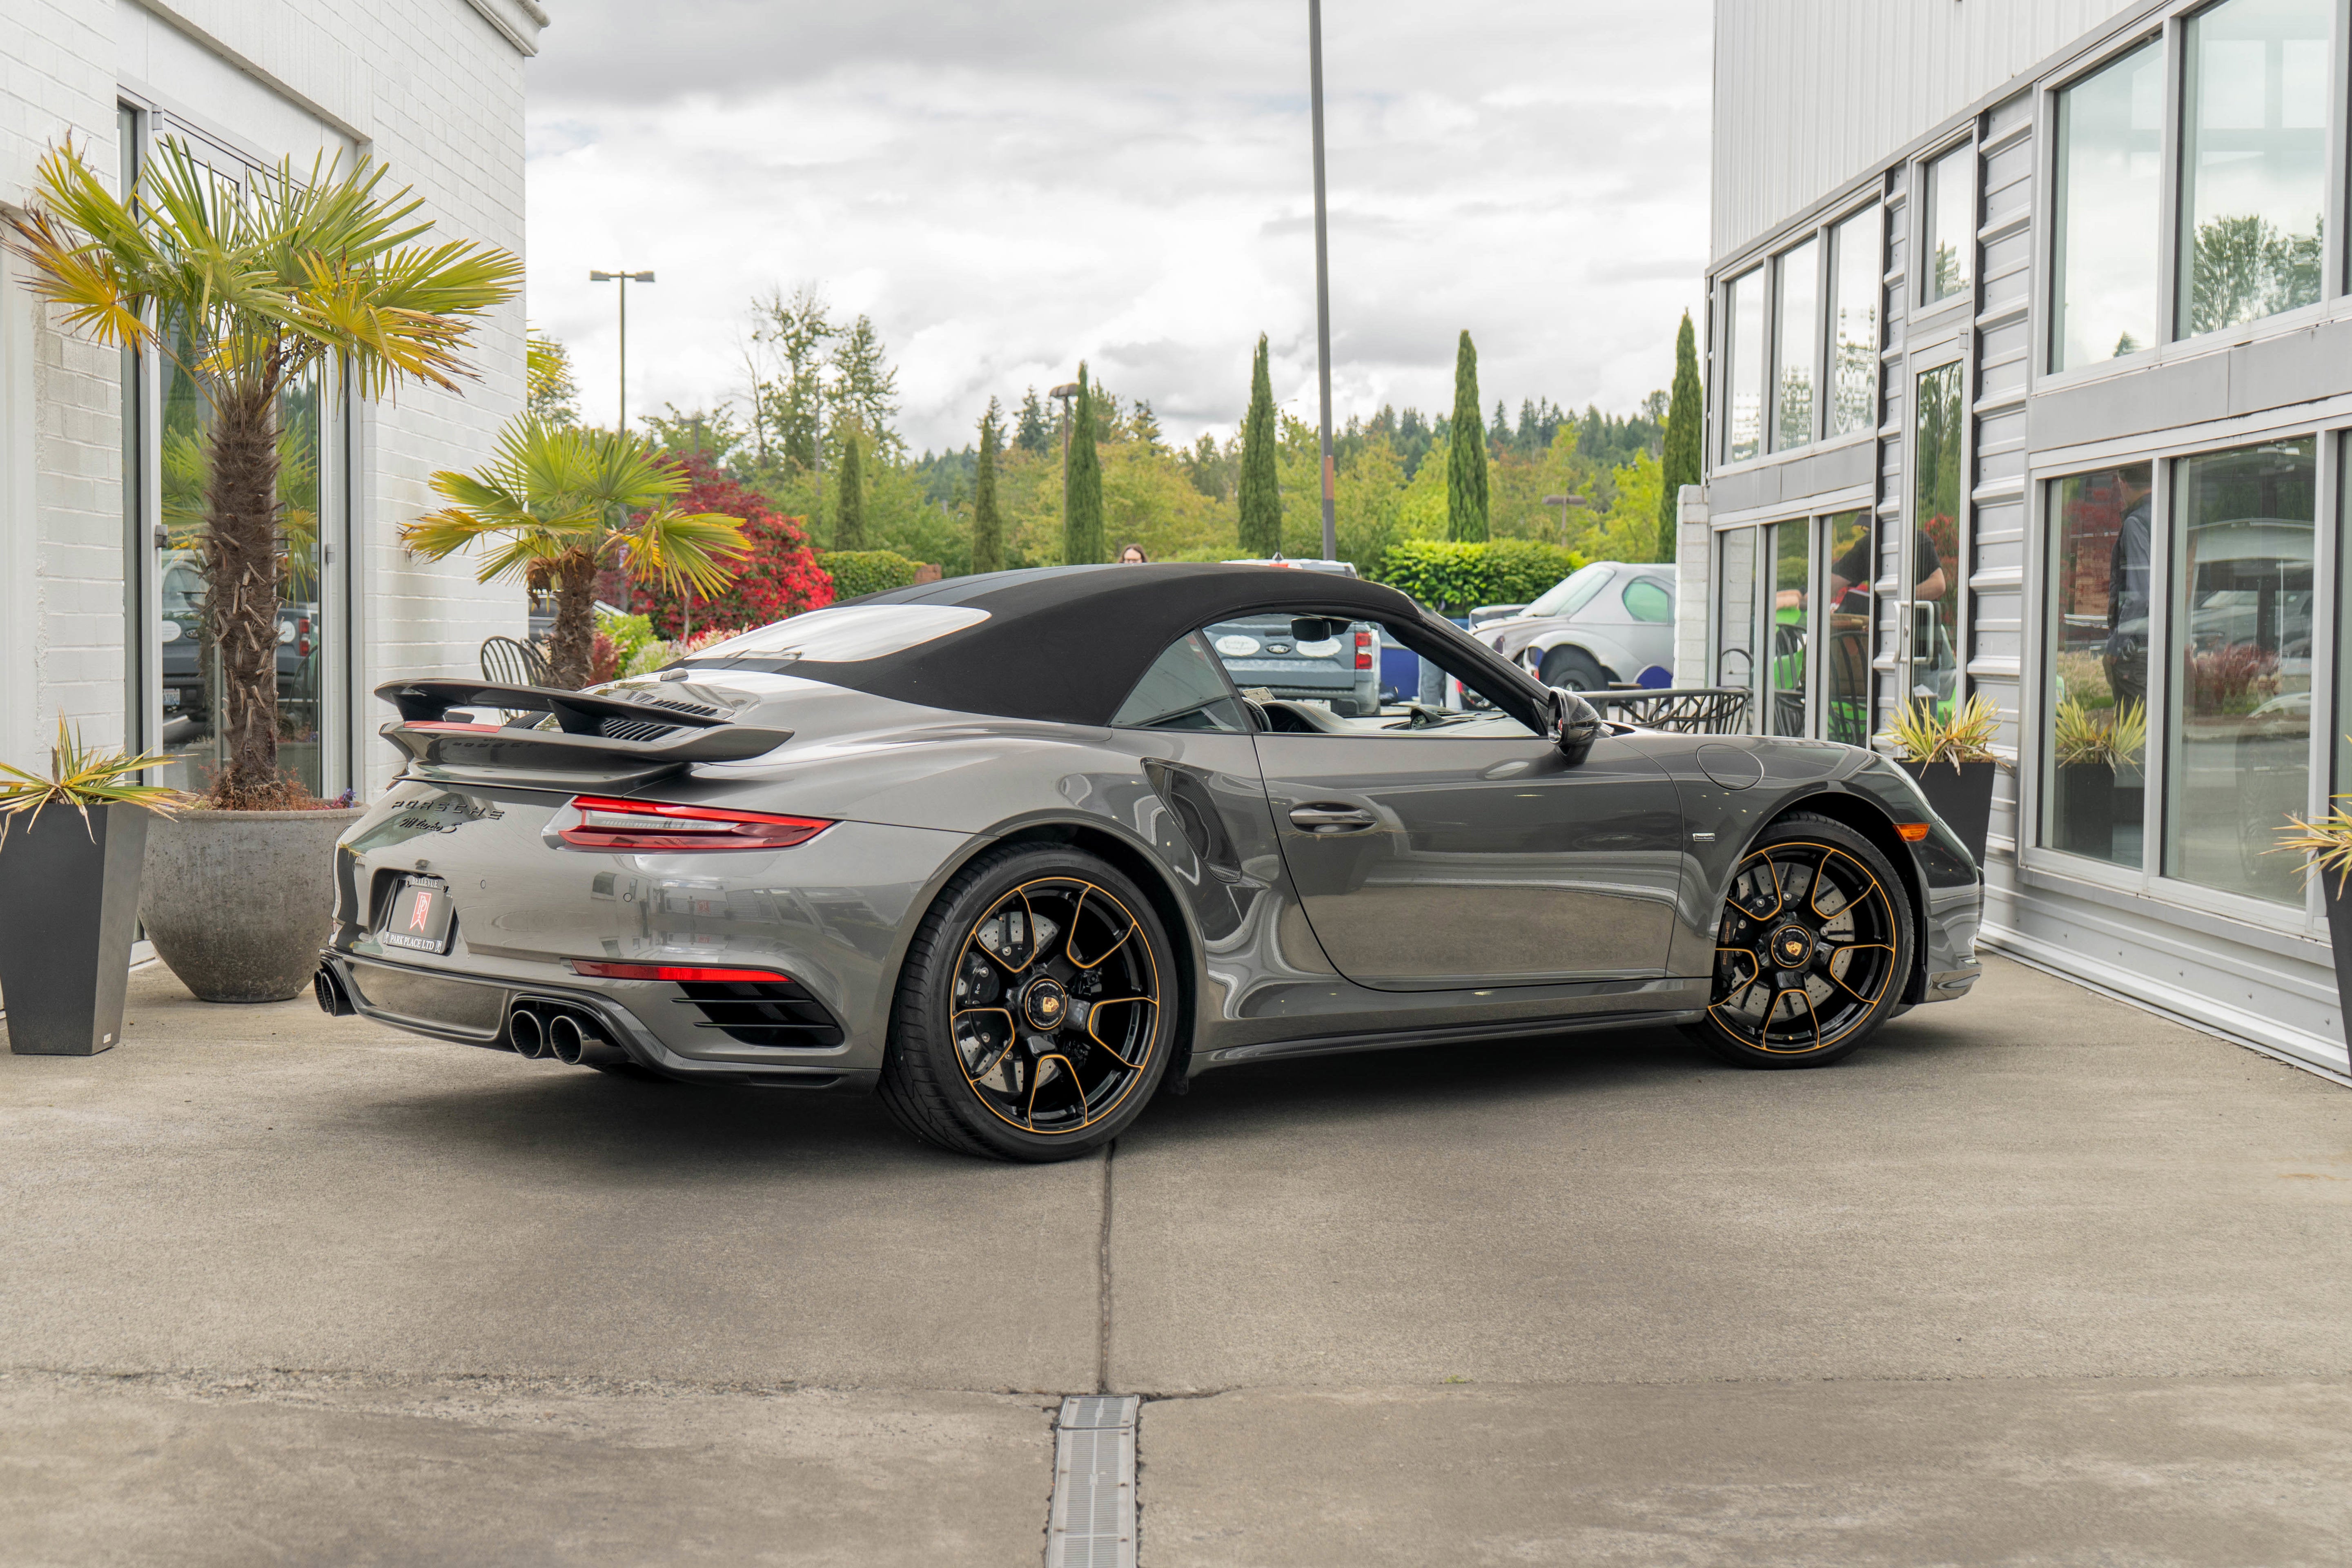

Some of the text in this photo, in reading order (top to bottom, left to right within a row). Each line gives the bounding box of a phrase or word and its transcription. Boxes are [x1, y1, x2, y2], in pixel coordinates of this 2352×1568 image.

[392, 800, 504, 820] PORSCHE
[440, 822, 462, 833] S
[412, 877, 438, 887] BELLEVUE
[390, 934, 404, 944] PARK
[403, 937, 422, 948] PLACE
[422, 940, 434, 950] LTD
